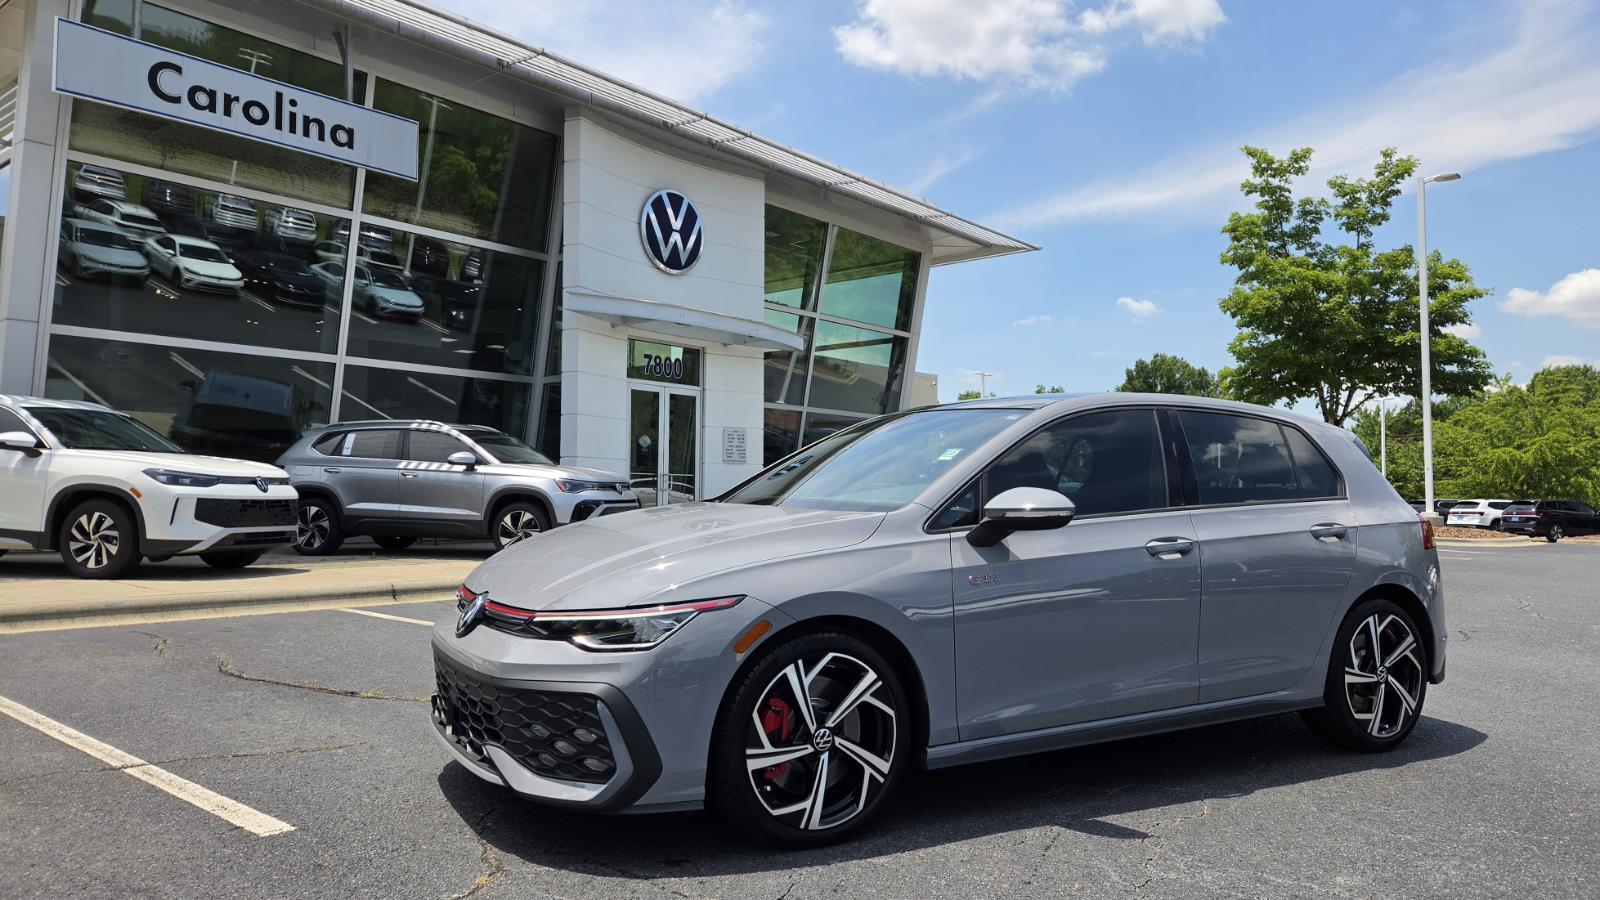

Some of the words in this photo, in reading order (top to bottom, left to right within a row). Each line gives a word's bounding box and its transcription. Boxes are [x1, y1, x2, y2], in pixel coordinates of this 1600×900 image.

[147, 61, 354, 150] Carolina
[642, 190, 703, 273] VW
[643, 353, 683, 379] 7800
